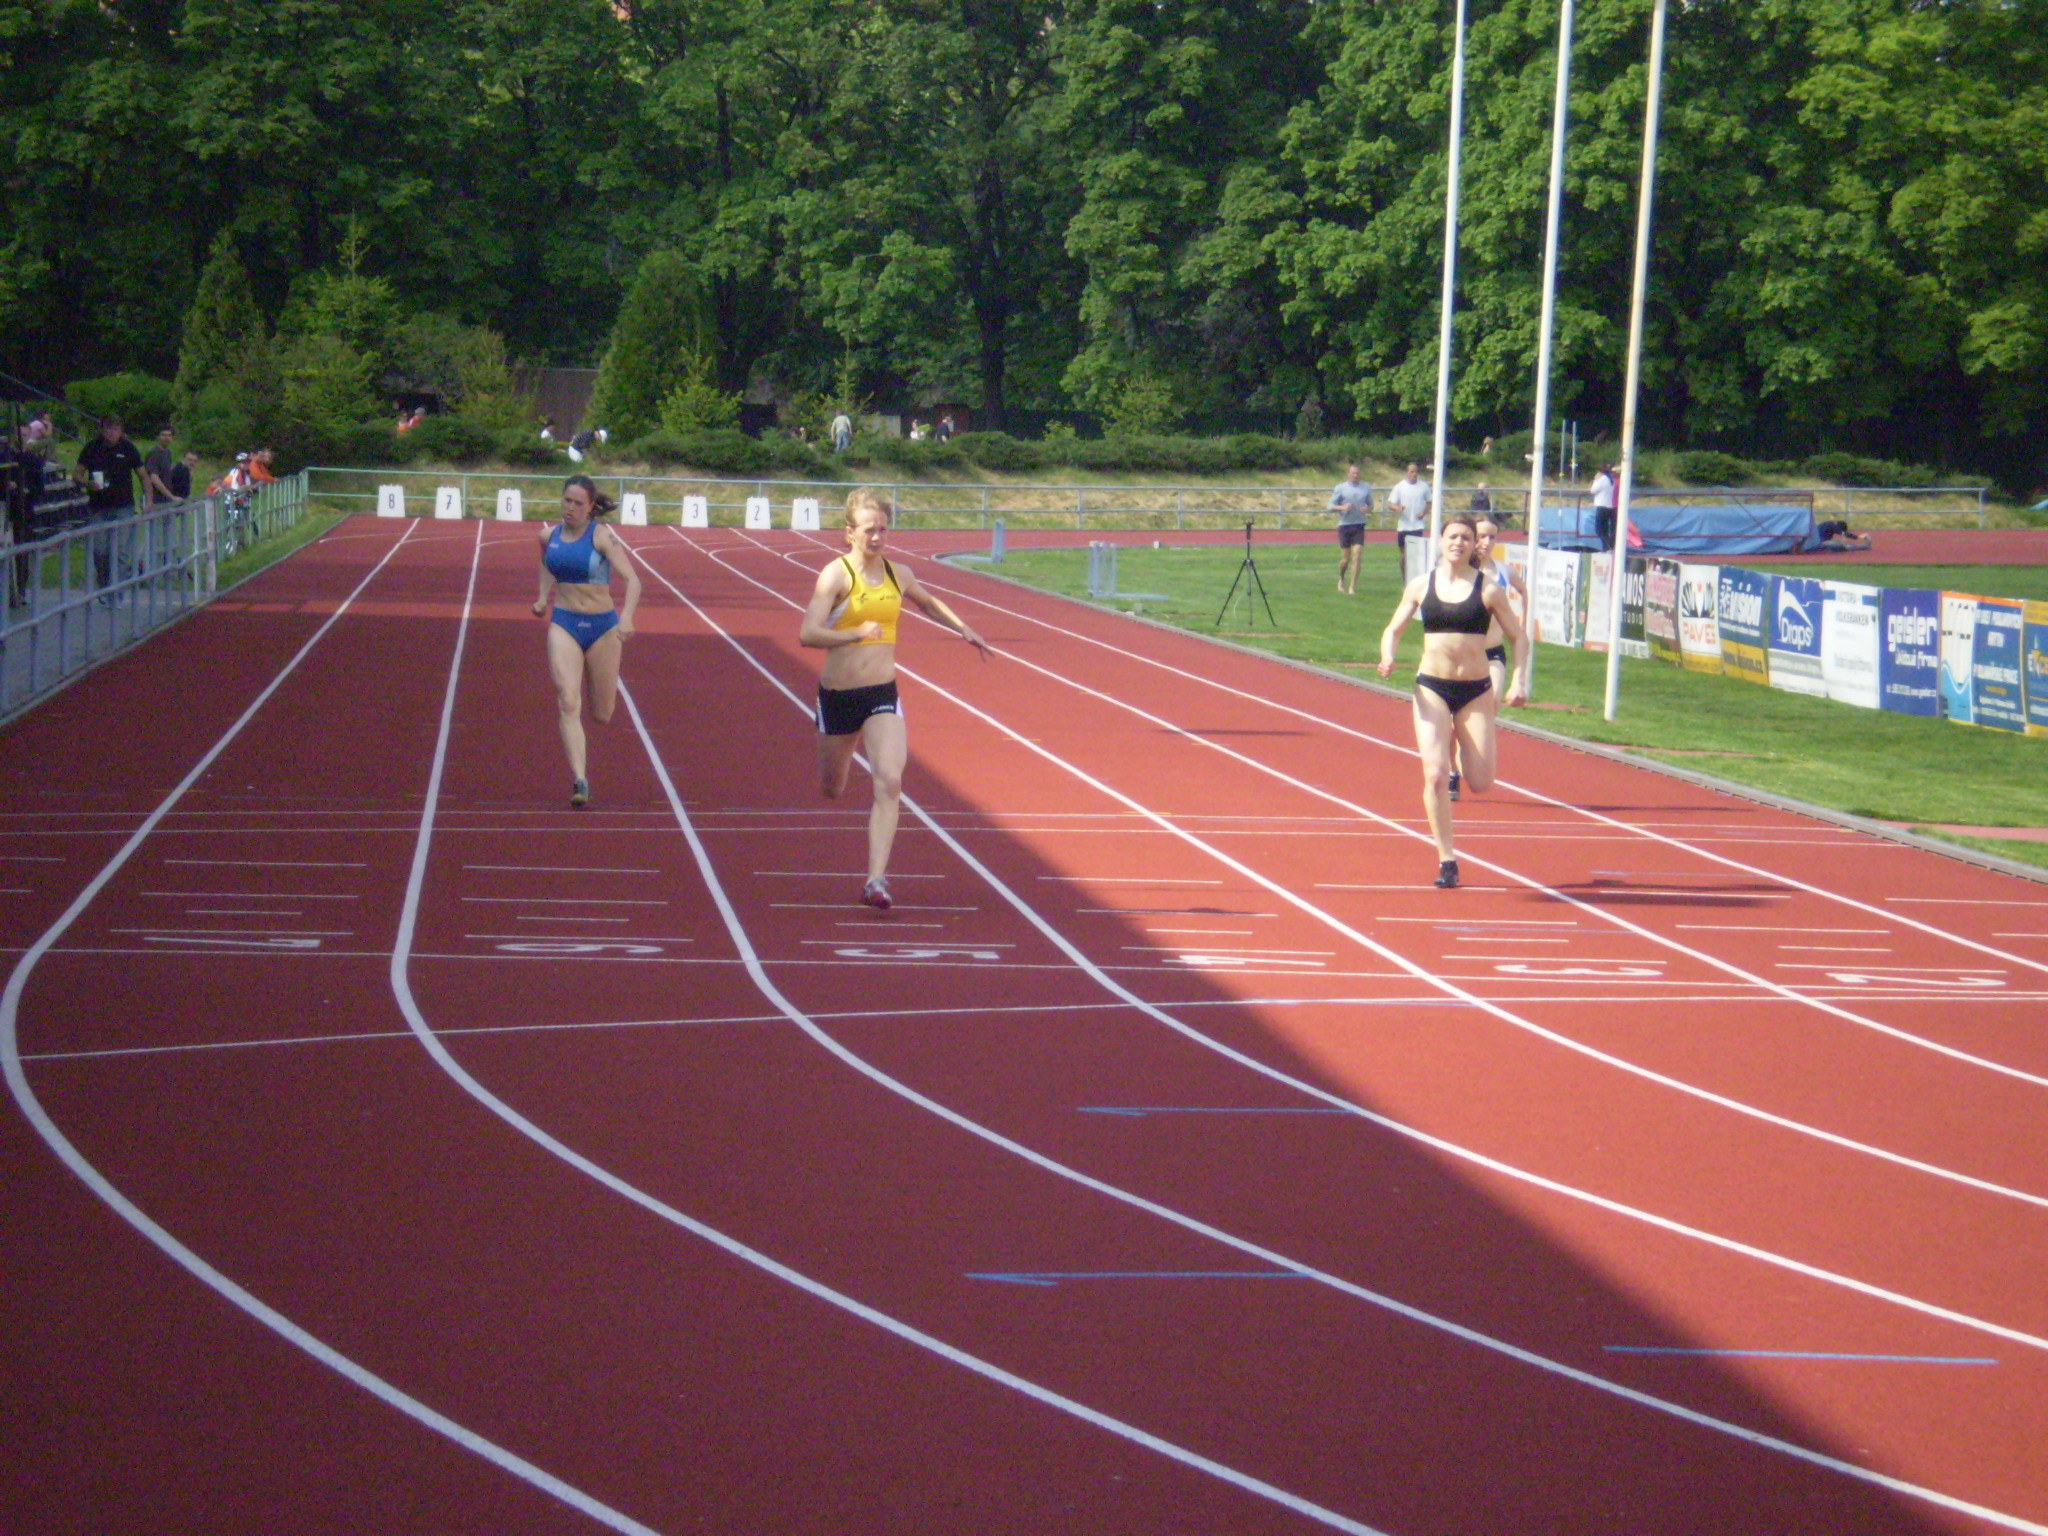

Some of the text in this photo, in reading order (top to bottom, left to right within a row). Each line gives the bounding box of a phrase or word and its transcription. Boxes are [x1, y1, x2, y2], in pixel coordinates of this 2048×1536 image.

[388, 494, 396, 509] 8
[445, 494, 453, 510] 7
[505, 496, 512, 512] 6
[630, 502, 637, 517] 4
[692, 503, 699, 519] 3
[754, 505, 760, 521] 2
[804, 507, 810, 522] 1
[1621, 611, 1643, 626] TUDIO
[1888, 606, 1937, 652] geisler
[144, 936, 321, 949] 7
[495, 942, 664, 955] 6
[834, 948, 1000, 960] 5
[1494, 964, 1664, 977] 3
[1826, 972, 2008, 987] 2
